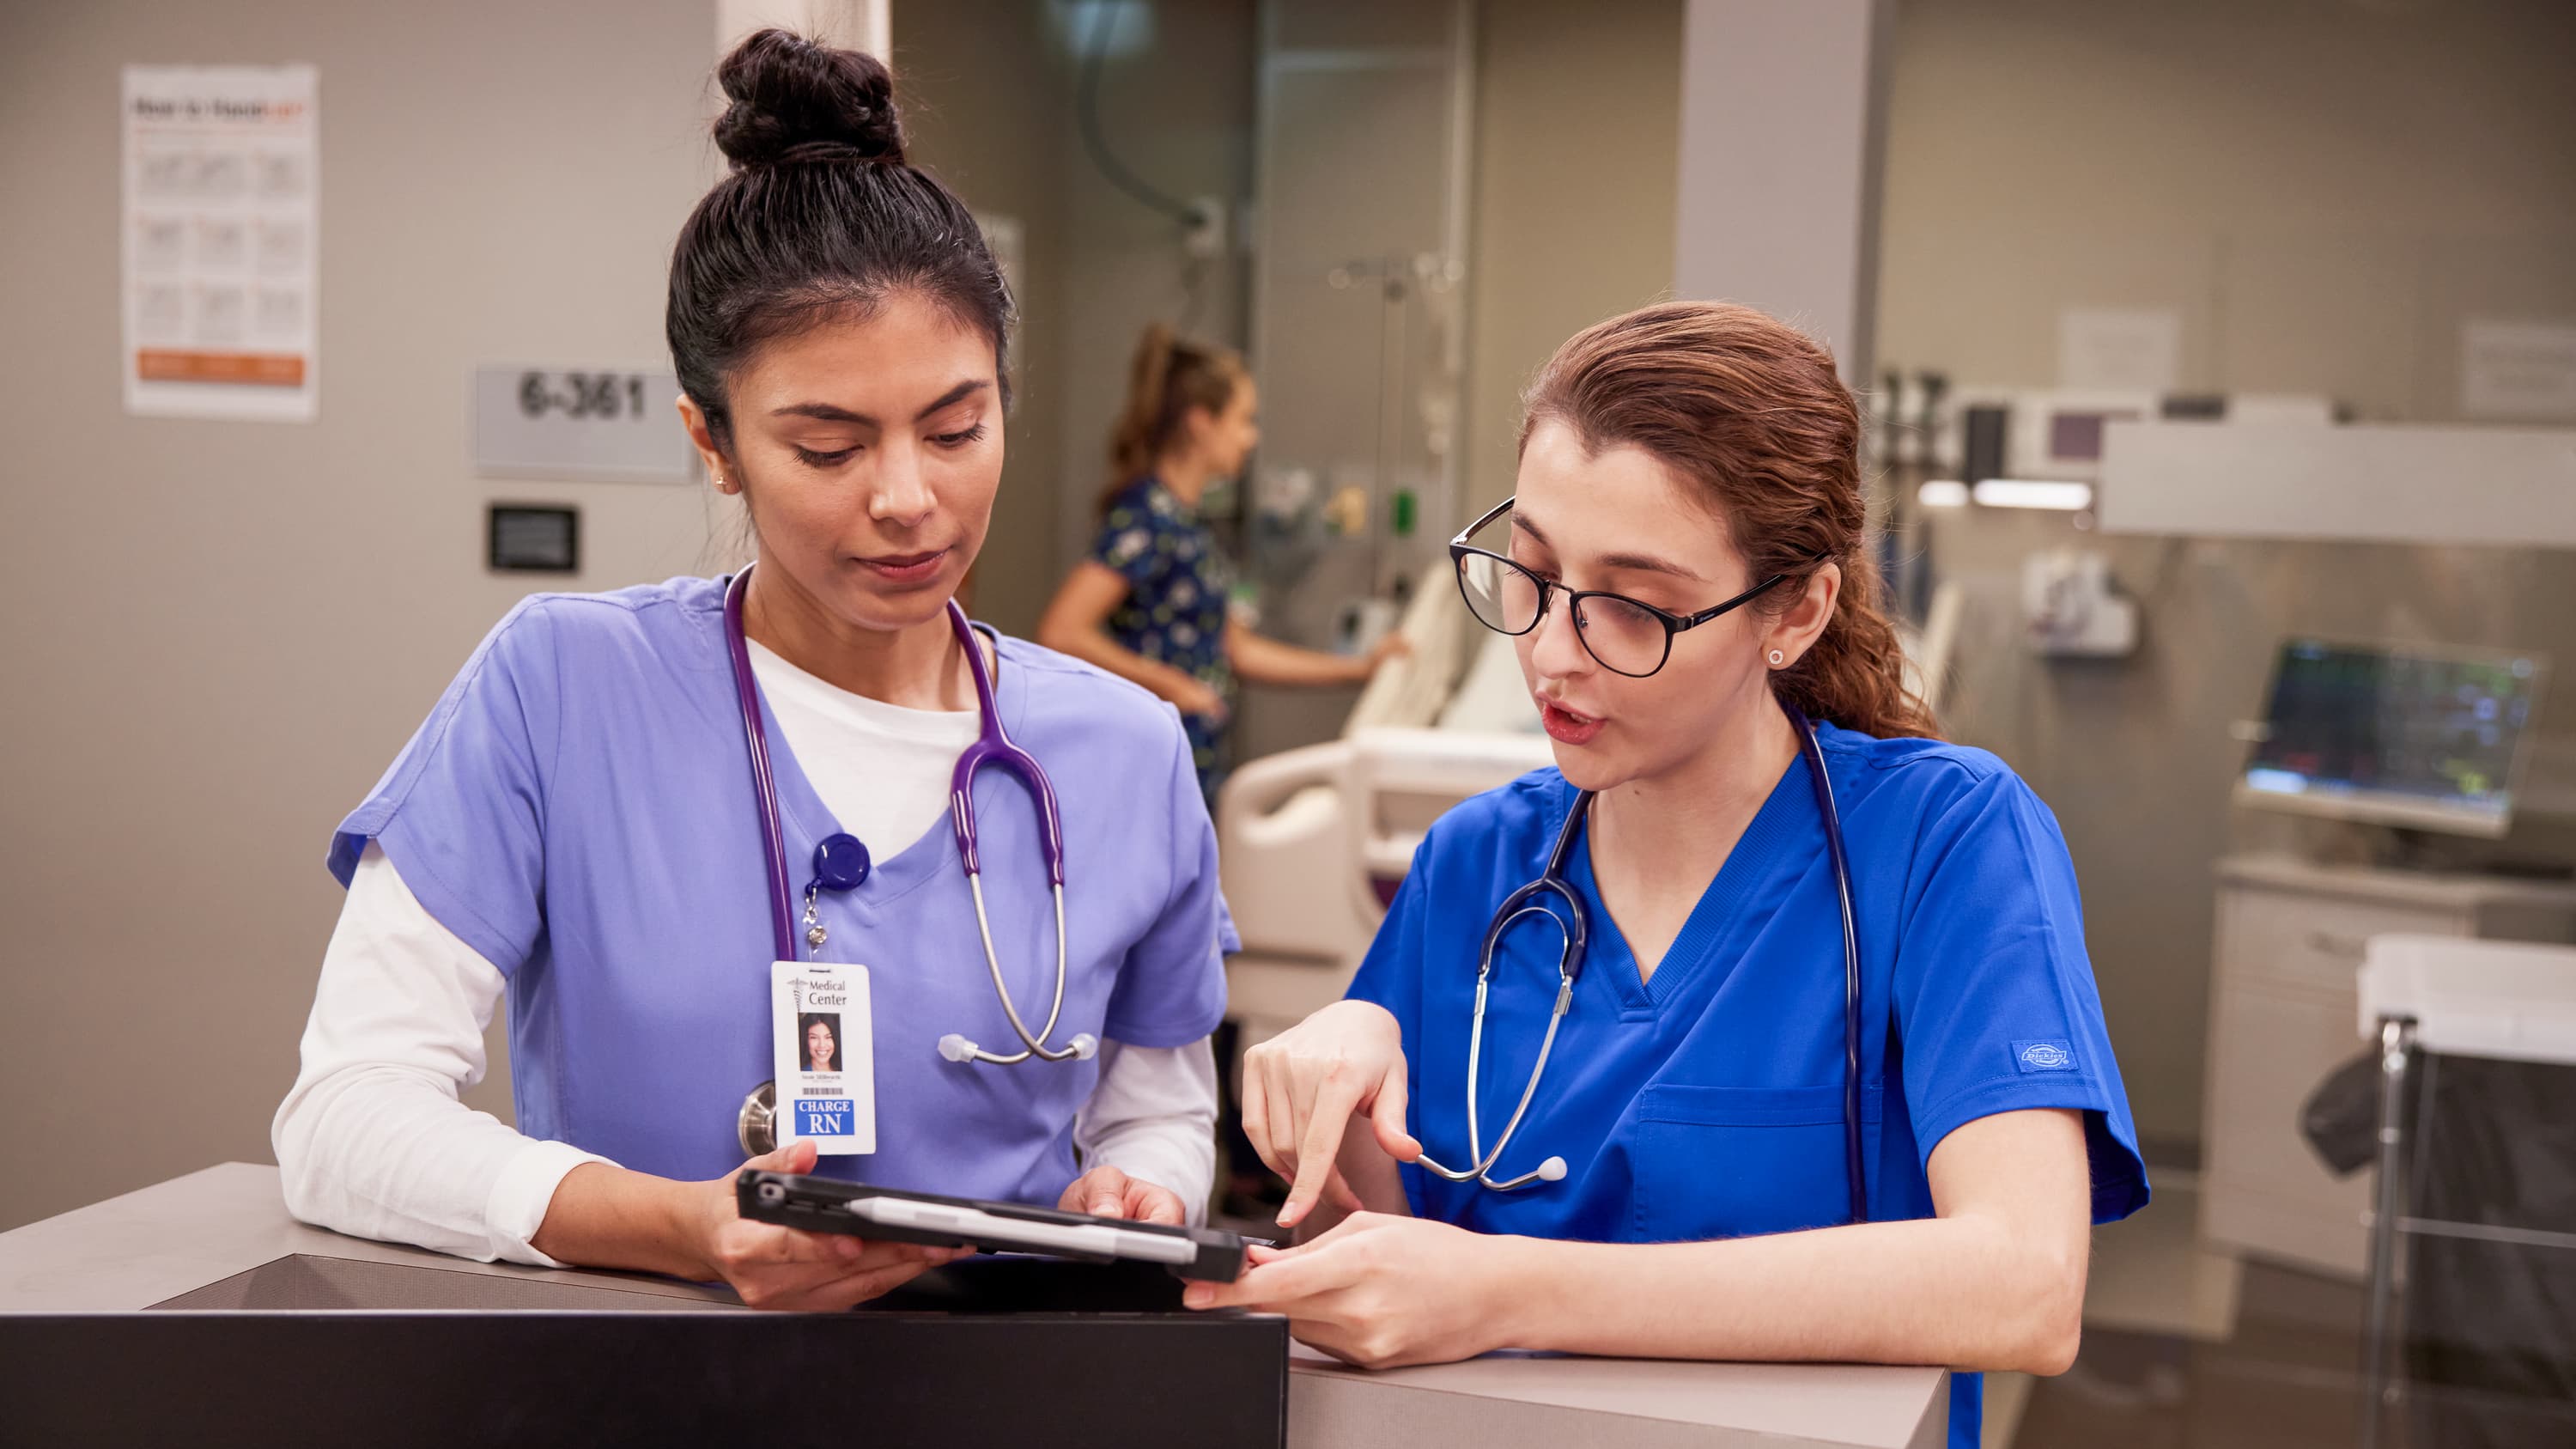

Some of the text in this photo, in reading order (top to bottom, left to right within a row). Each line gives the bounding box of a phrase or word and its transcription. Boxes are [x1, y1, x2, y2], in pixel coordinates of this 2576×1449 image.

[519, 371, 645, 420] 6-361
[810, 980, 846, 991] Medical
[809, 992, 847, 1006] Center
[799, 1101, 850, 1112] CHARGE
[808, 1113, 841, 1134] RN
